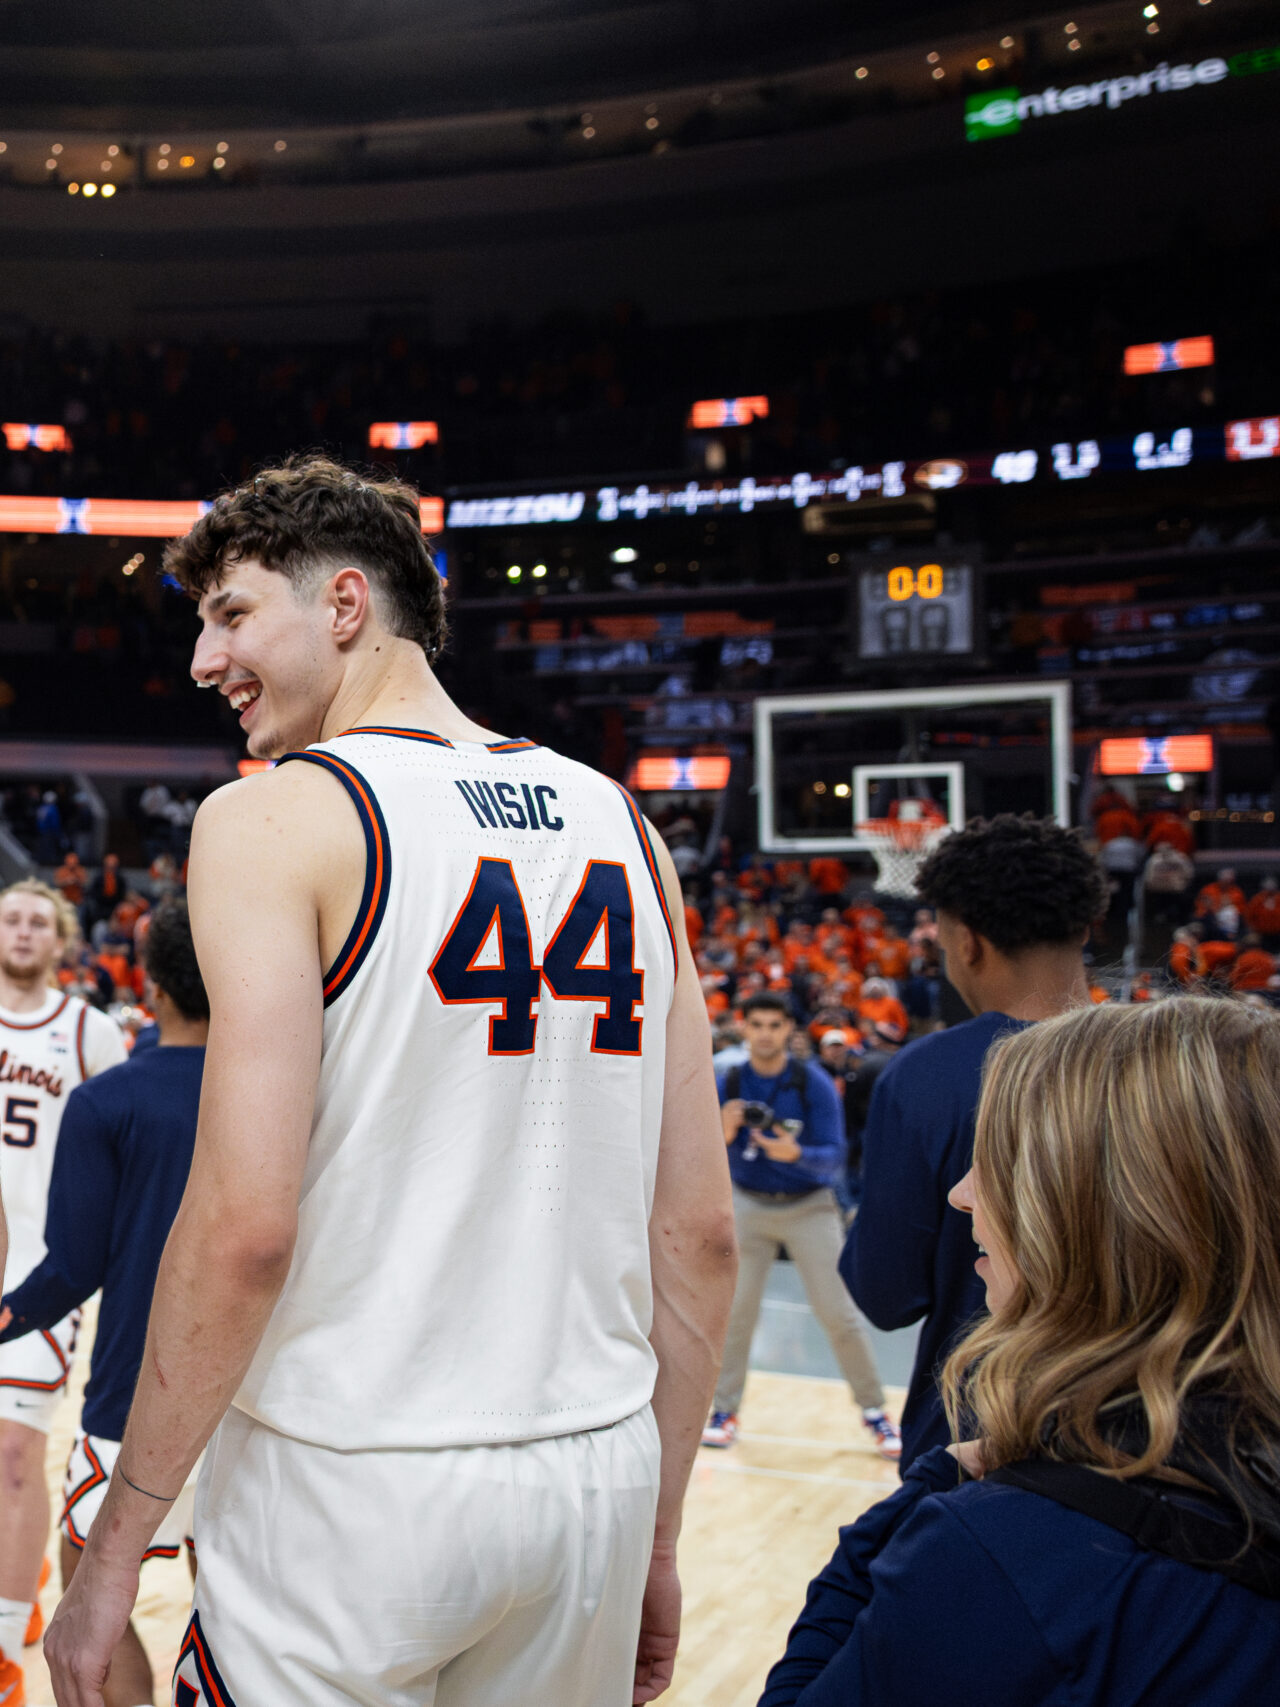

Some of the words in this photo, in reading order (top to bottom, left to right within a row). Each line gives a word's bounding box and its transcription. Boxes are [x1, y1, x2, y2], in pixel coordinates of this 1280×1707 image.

[965, 57, 1229, 126] enterprise
[446, 491, 585, 528] MIZZOU
[454, 779, 565, 831] IVISIC
[427, 855, 645, 1057] 44
